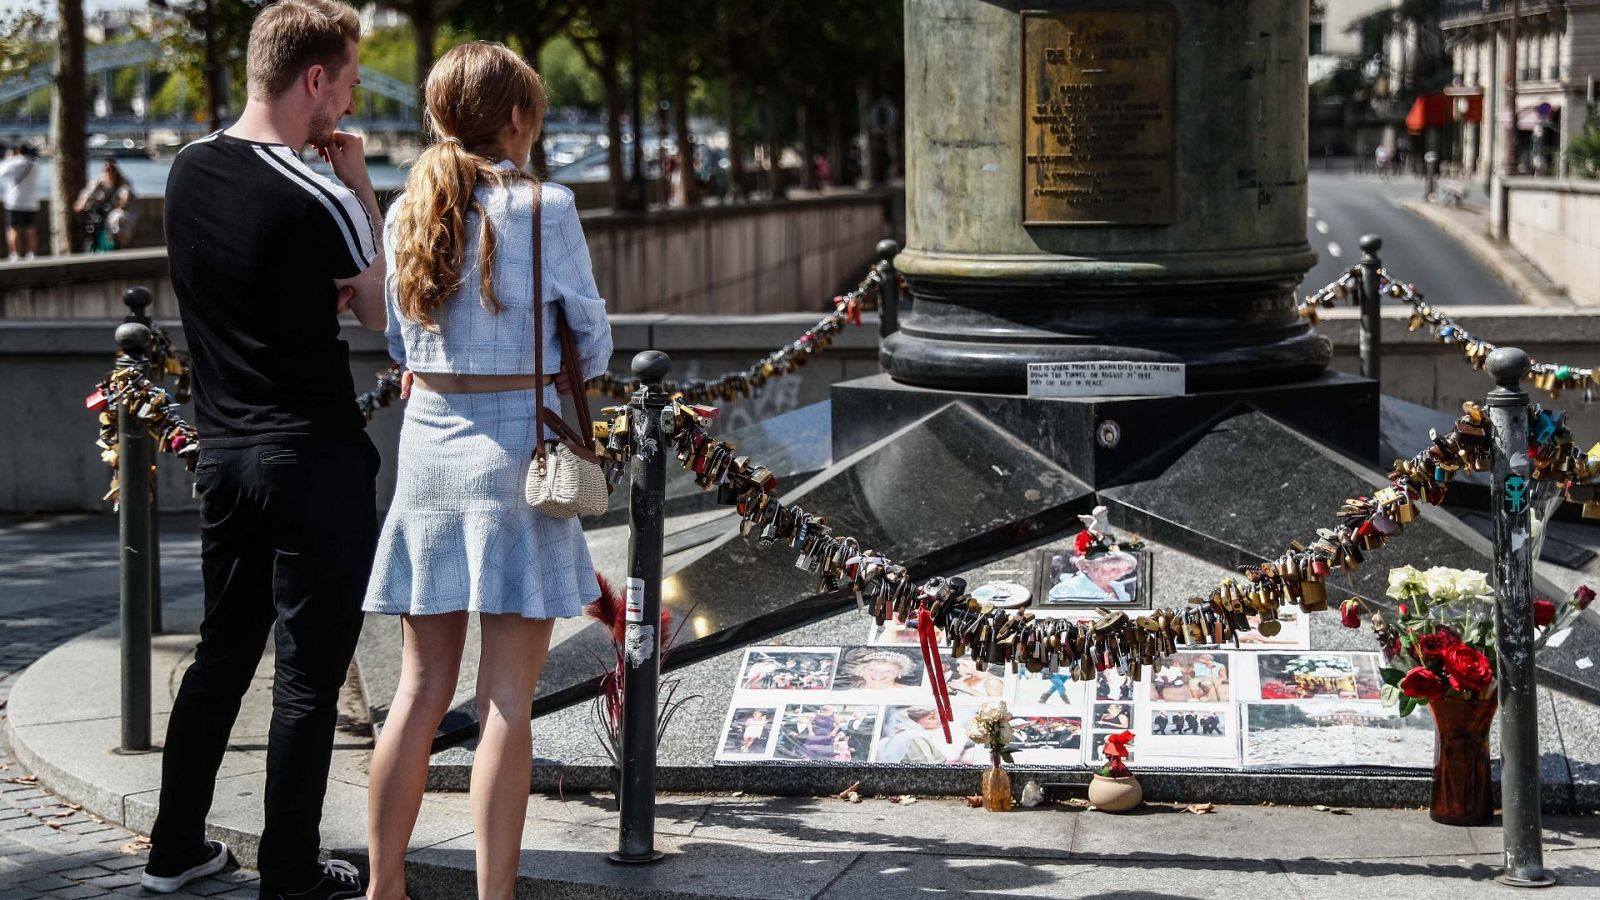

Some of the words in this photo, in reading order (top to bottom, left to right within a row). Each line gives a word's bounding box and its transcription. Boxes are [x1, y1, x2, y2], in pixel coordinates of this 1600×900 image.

[1098, 363, 1117, 371] DIANA
[1118, 363, 1133, 371] DIED
[1101, 371, 1124, 379] AUGUST
